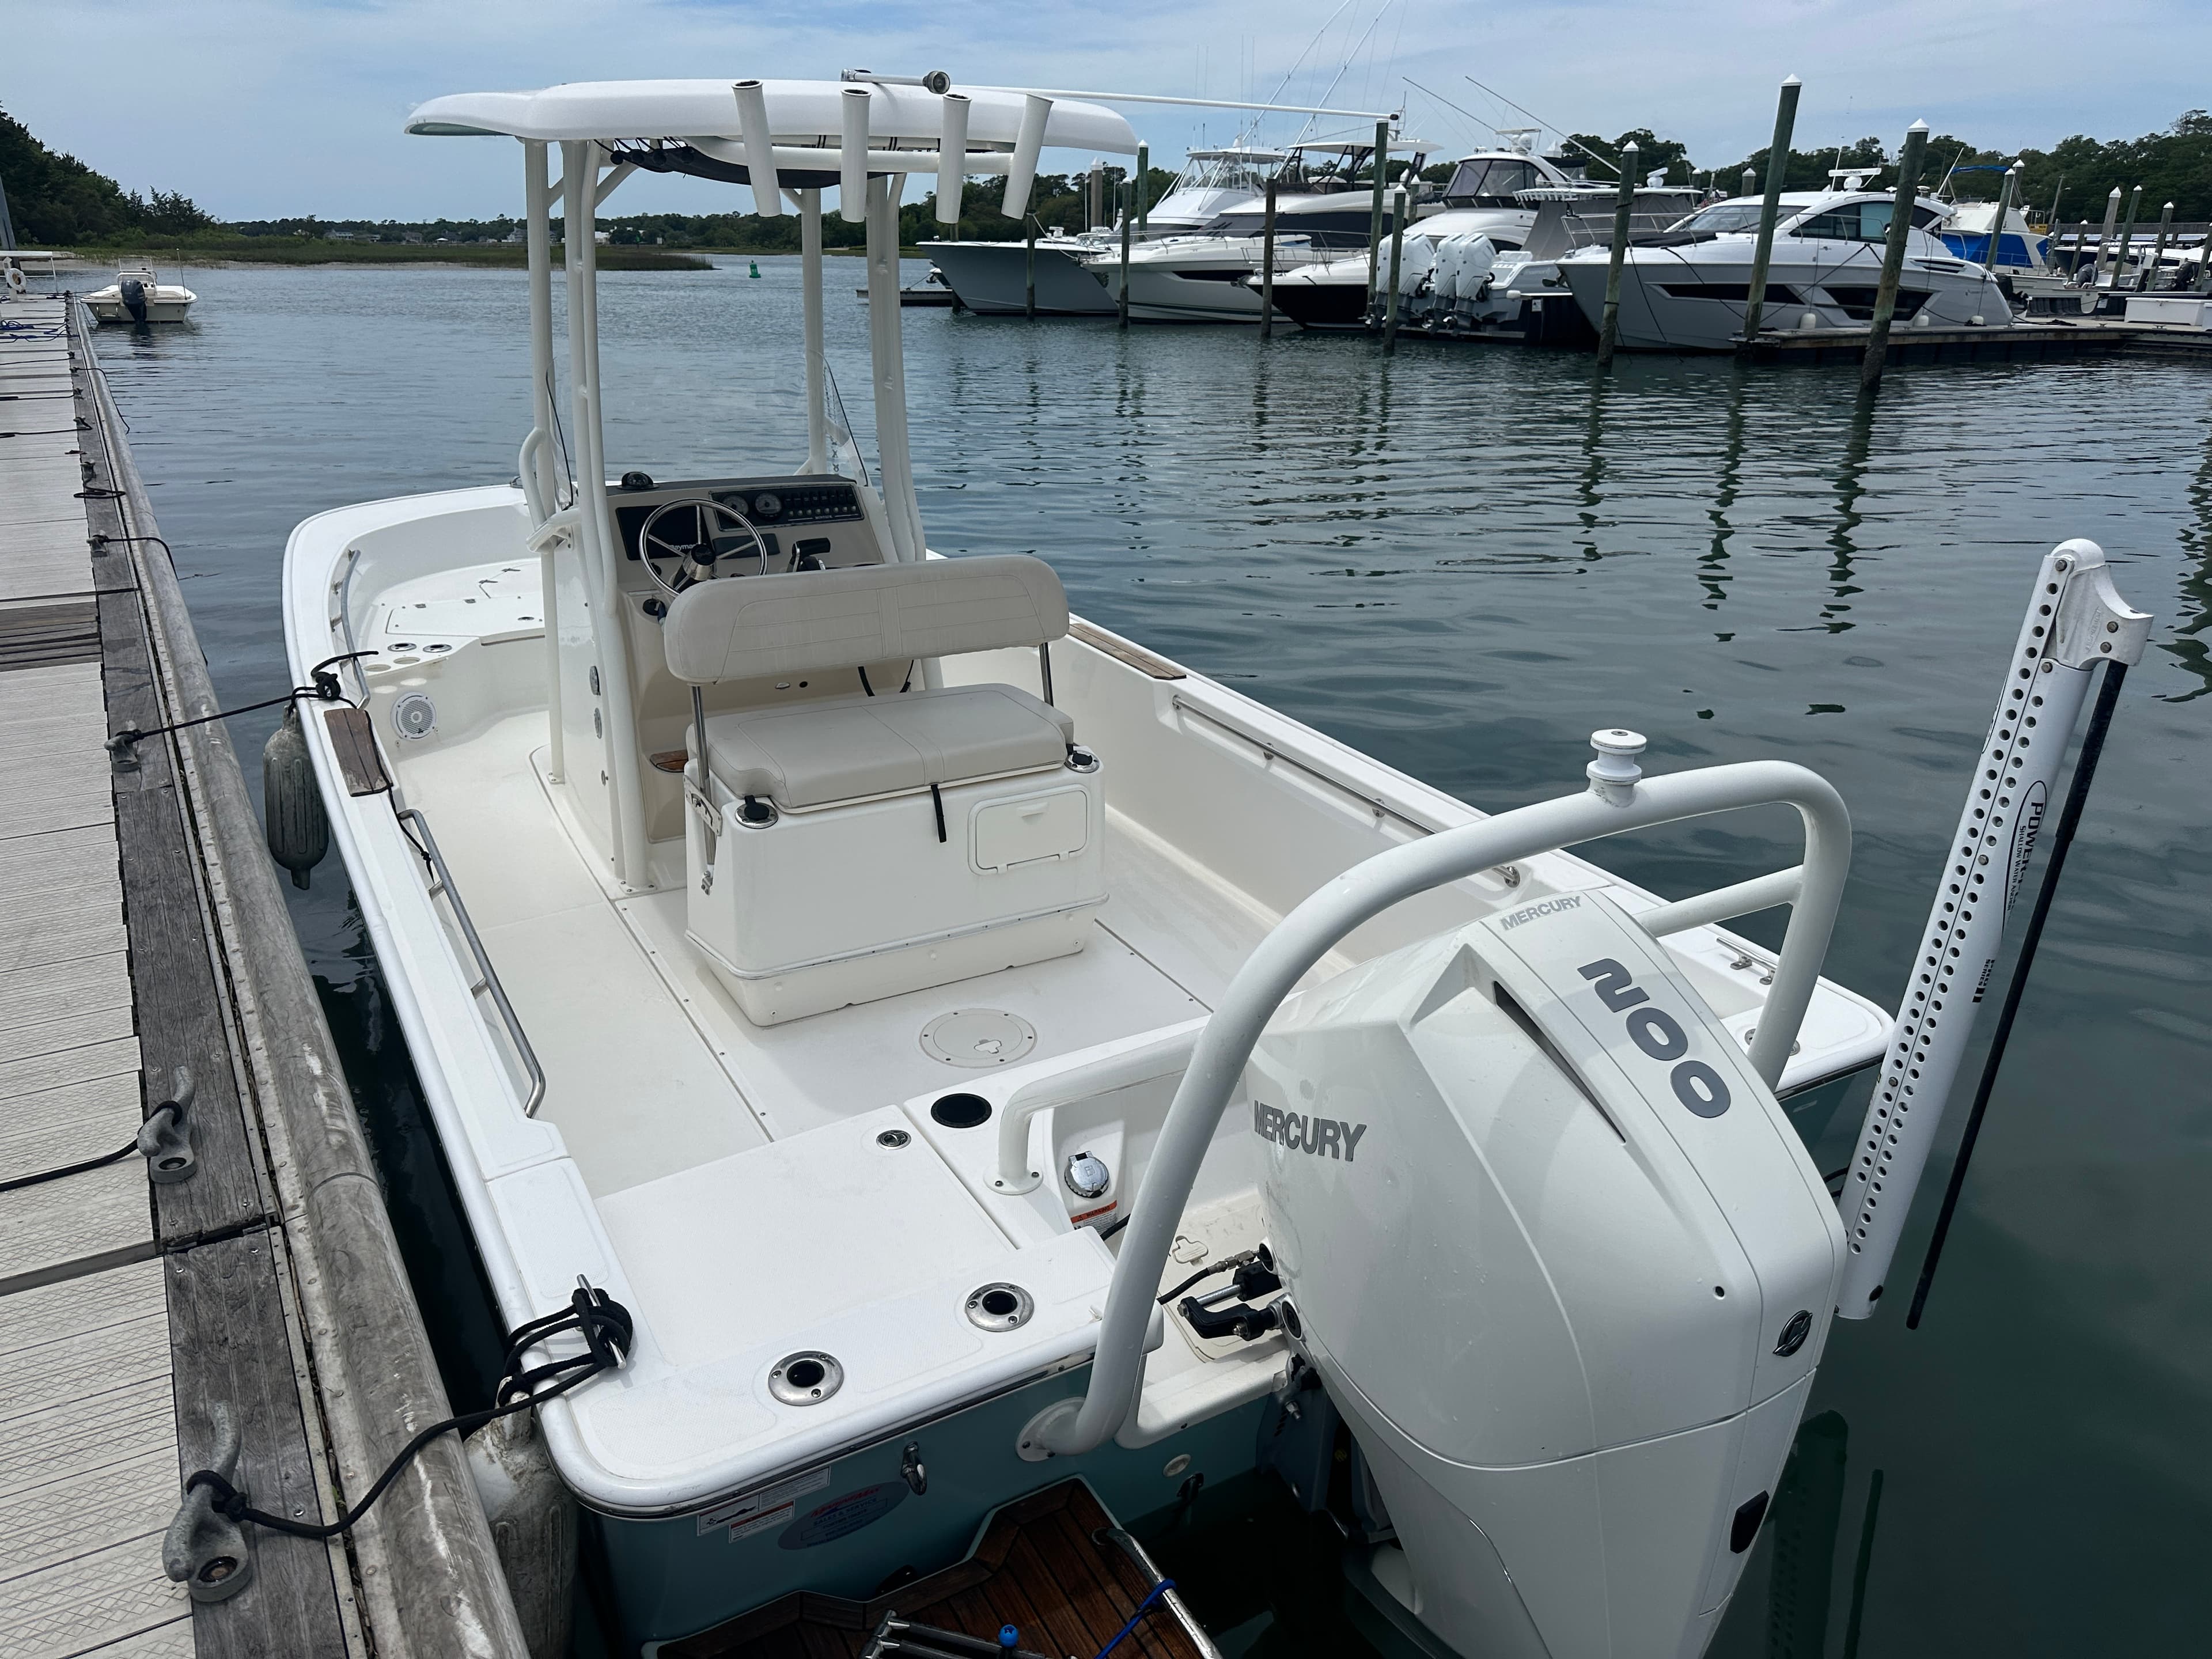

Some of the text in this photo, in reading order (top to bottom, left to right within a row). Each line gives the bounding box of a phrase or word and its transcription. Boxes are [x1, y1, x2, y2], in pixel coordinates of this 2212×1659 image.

[2016, 825, 2027, 858] SHALLOW
[2012, 859, 2021, 883] WATER
[1501, 896, 1580, 931] MERCURY
[1978, 959, 1991, 986] SERIES
[1577, 958, 1731, 1119] 200
[1254, 1100, 1367, 1162] MERCURY
[846, 1497, 877, 1514] SERVICE
